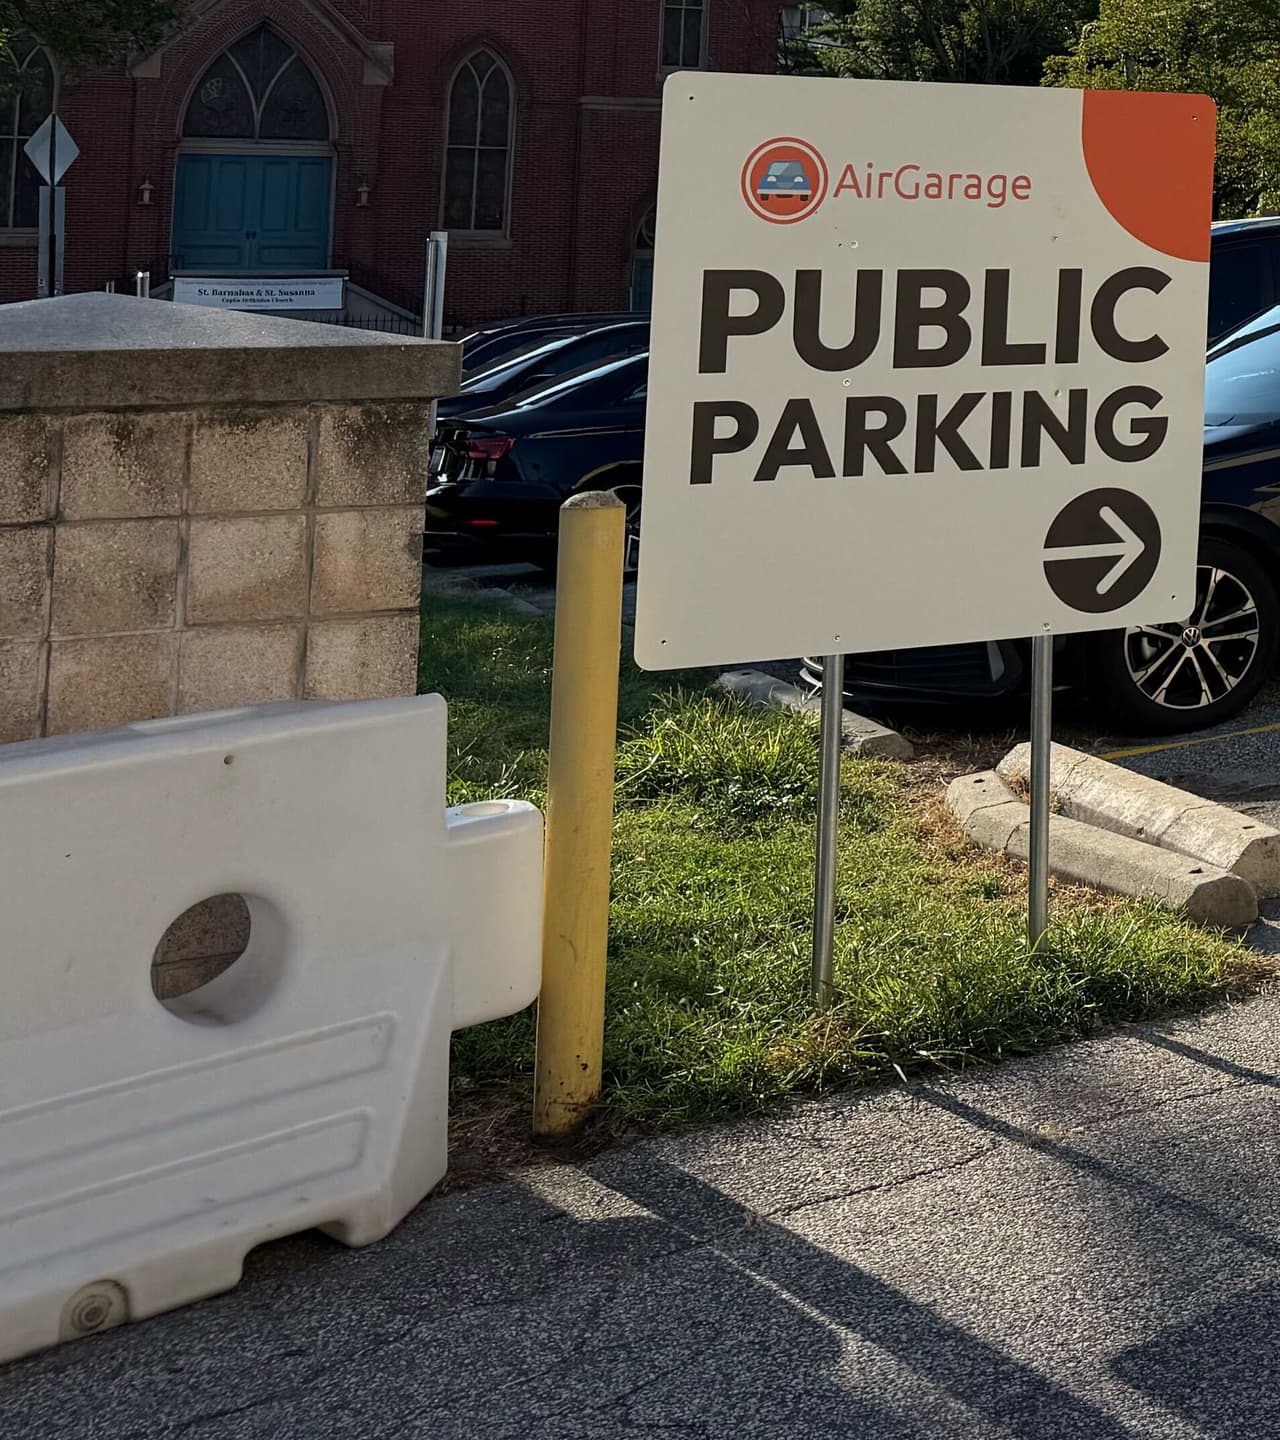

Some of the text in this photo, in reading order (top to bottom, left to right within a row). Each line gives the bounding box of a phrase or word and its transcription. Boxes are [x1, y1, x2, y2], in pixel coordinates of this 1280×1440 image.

[833, 162, 1032, 208] AirGarage
[278, 288, 315, 297] Susanna
[698, 266, 1173, 374] PUBLIC
[689, 384, 1169, 485] PARKING
